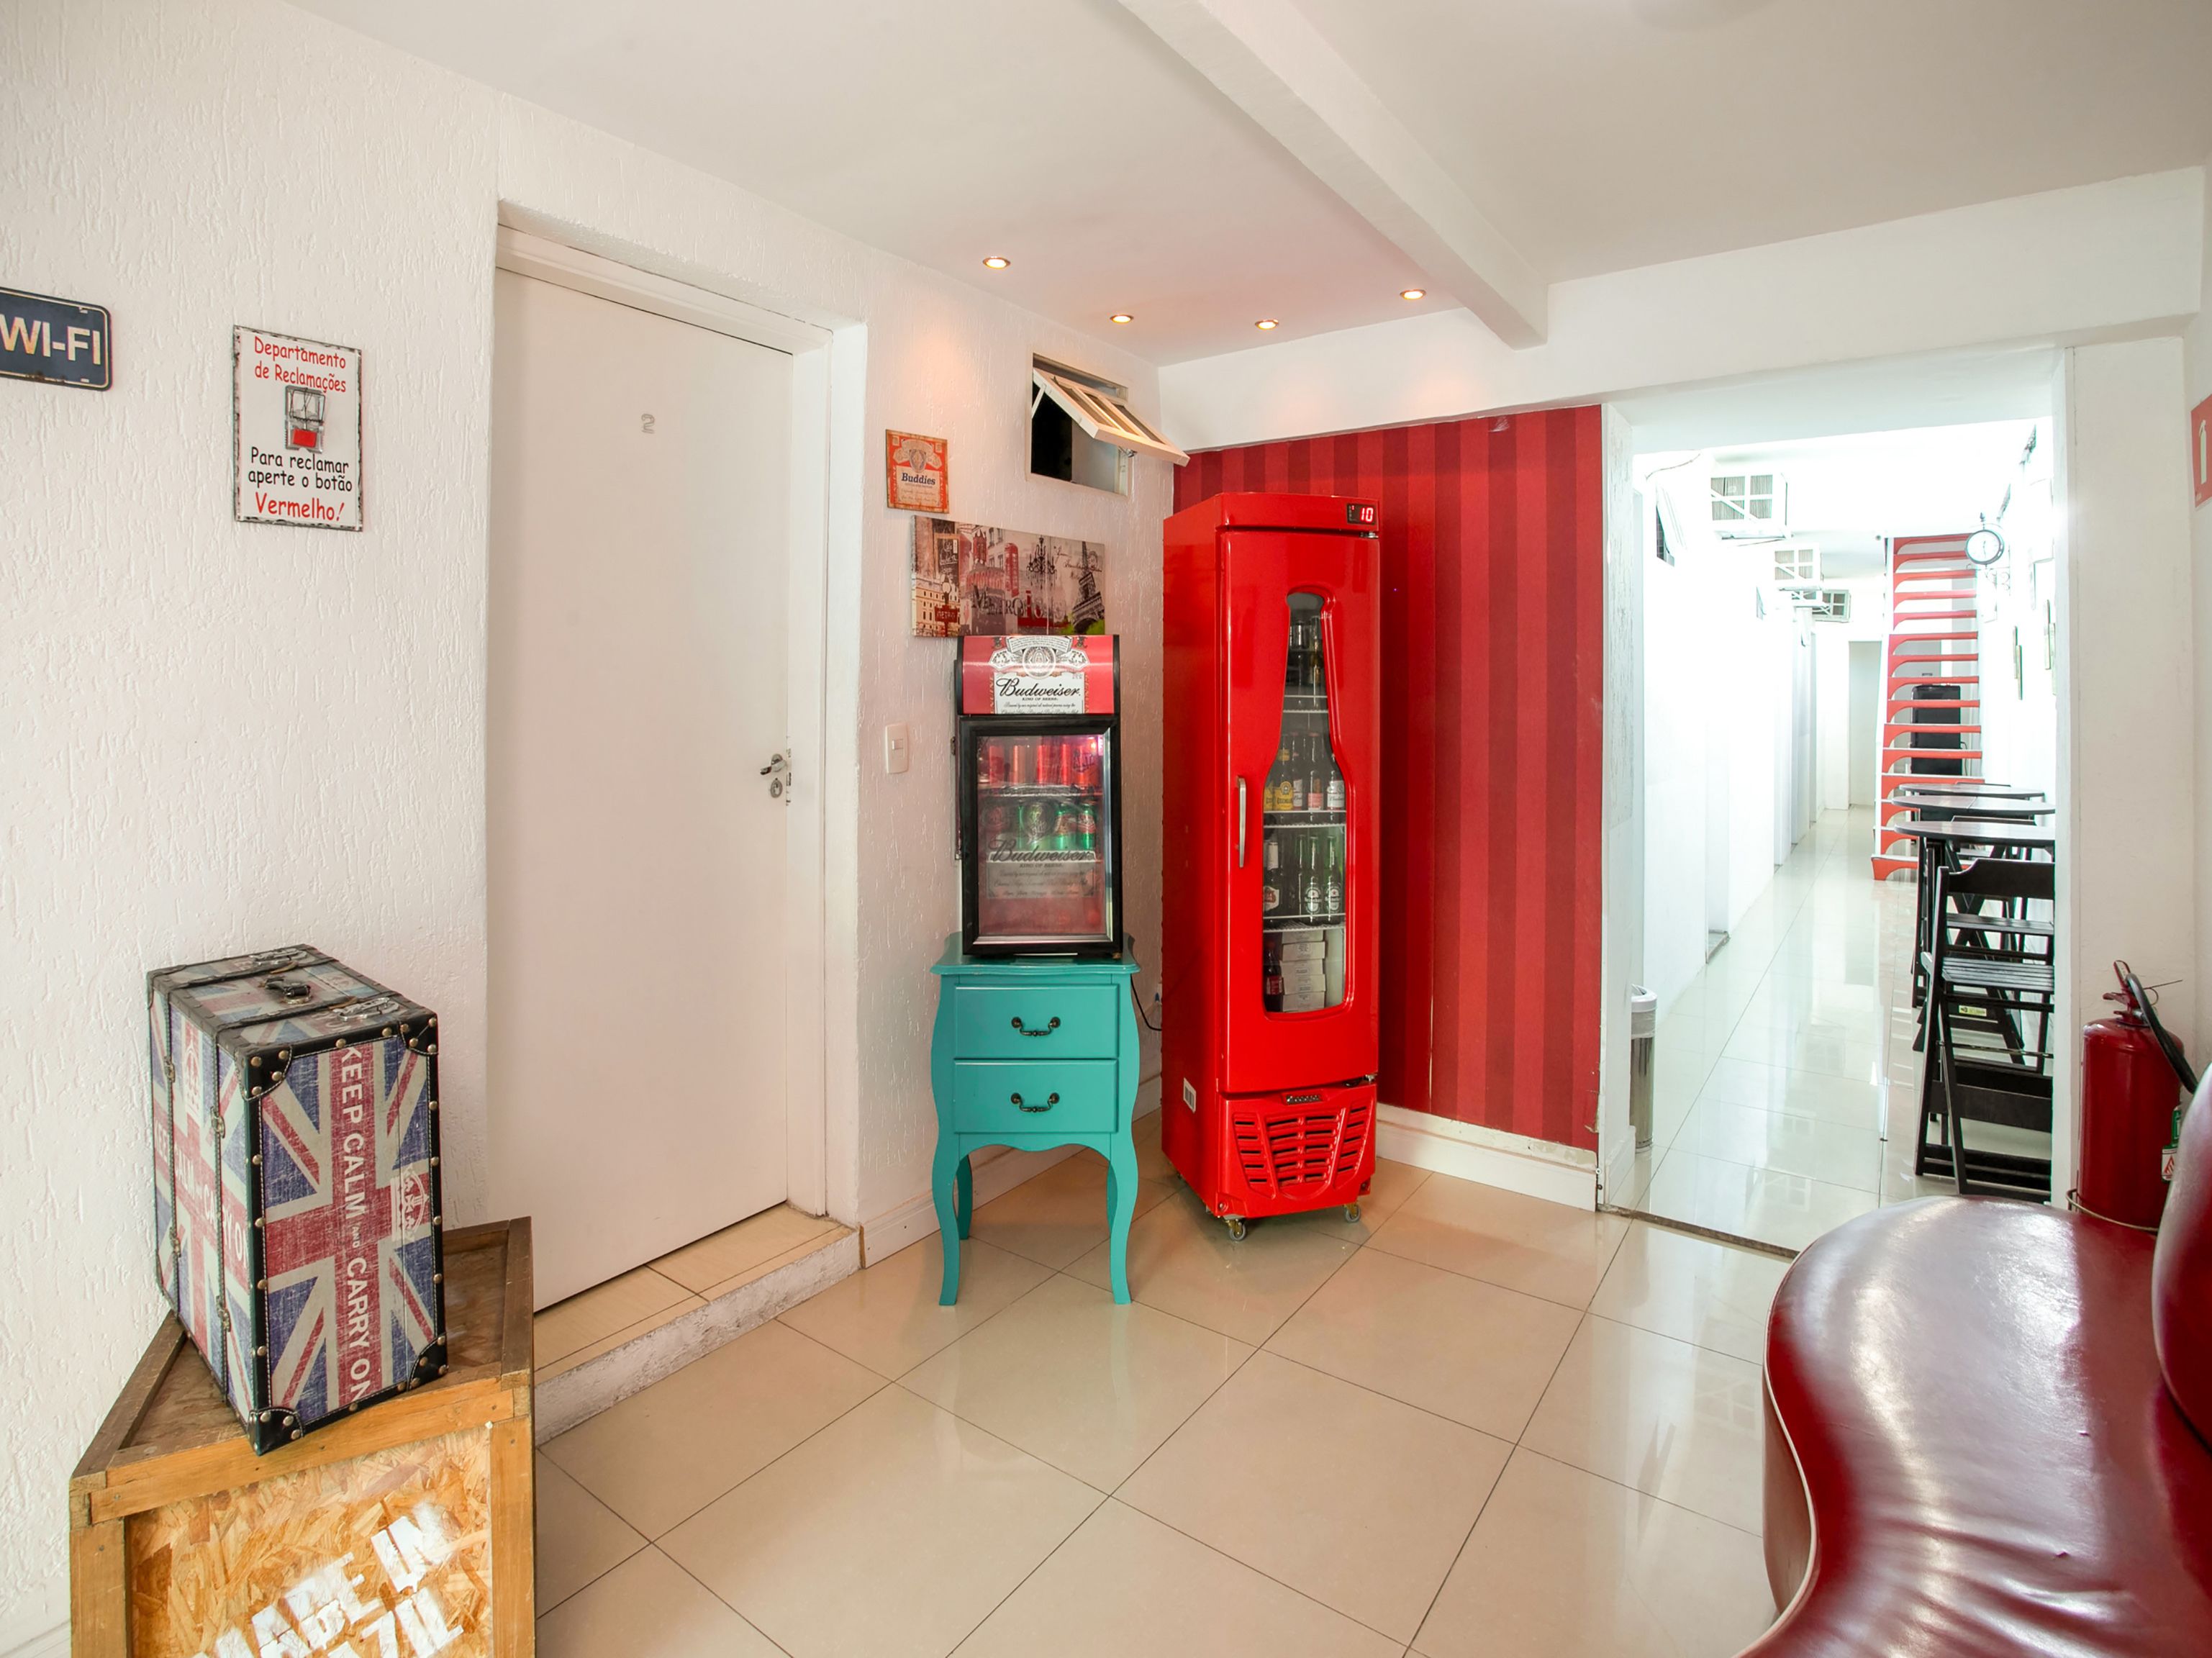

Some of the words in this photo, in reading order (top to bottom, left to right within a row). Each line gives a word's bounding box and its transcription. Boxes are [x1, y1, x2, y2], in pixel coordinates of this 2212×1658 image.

[0, 313, 101, 365] WI-FI
[255, 336, 346, 368] Departamento
[255, 361, 269, 379] de
[275, 363, 346, 394] Reclamações
[641, 413, 655, 434] 2
[251, 446, 283, 467] Para
[290, 453, 349, 474] reclamar
[248, 470, 295, 489] aperte
[302, 476, 309, 487] o
[315, 472, 353, 491] botão
[901, 472, 936, 485] Buddies
[255, 491, 345, 522] Vermelho!
[1361, 507, 1374, 522] 10
[996, 678, 1081, 697] Budweiser
[989, 839, 1090, 861] Budweiser
[341, 1047, 363, 1124] KEEP
[343, 1133, 367, 1220] CALM
[351, 1226, 360, 1249] AND
[347, 1257, 370, 1349] CARRY
[350, 1357, 371, 1403] ON
